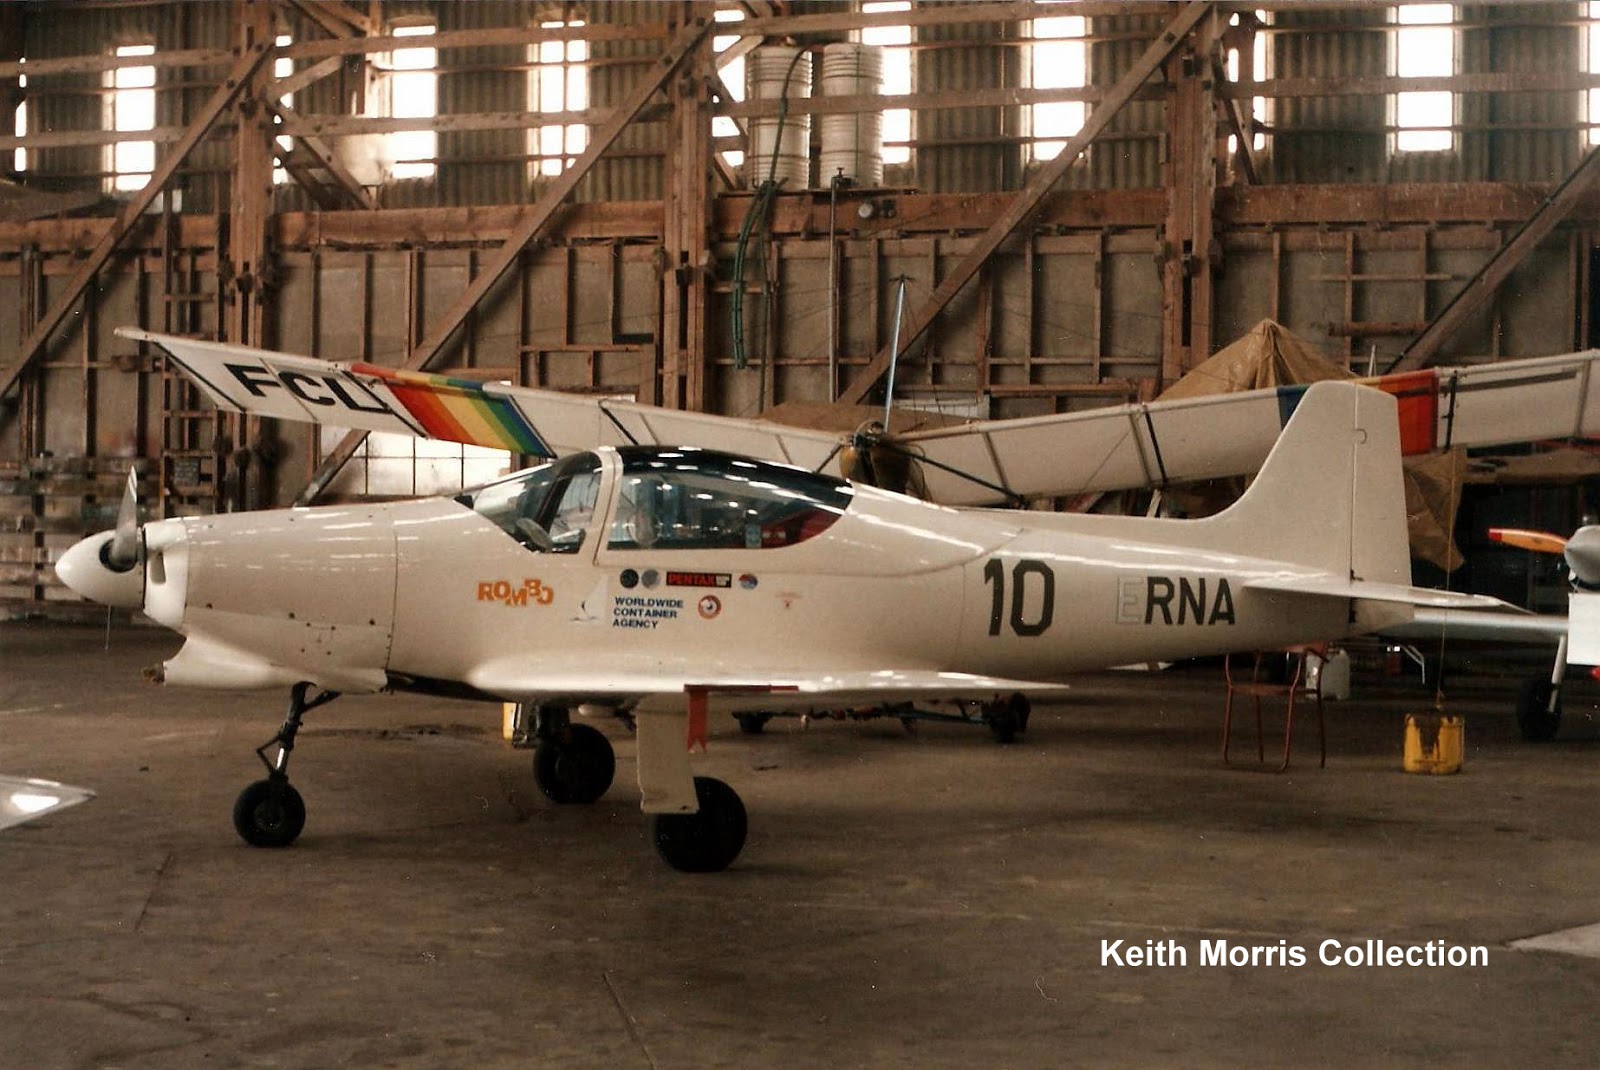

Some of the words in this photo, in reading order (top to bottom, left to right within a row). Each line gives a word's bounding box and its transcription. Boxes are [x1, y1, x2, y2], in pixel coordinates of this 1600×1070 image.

[668, 572, 715, 587] PENTAX
[477, 578, 554, 607] ROMBO
[983, 558, 1055, 637] 10
[614, 596, 684, 609] WORLDWIDE
[613, 607, 678, 619] CONTAINER
[612, 618, 659, 630] AGENCY
